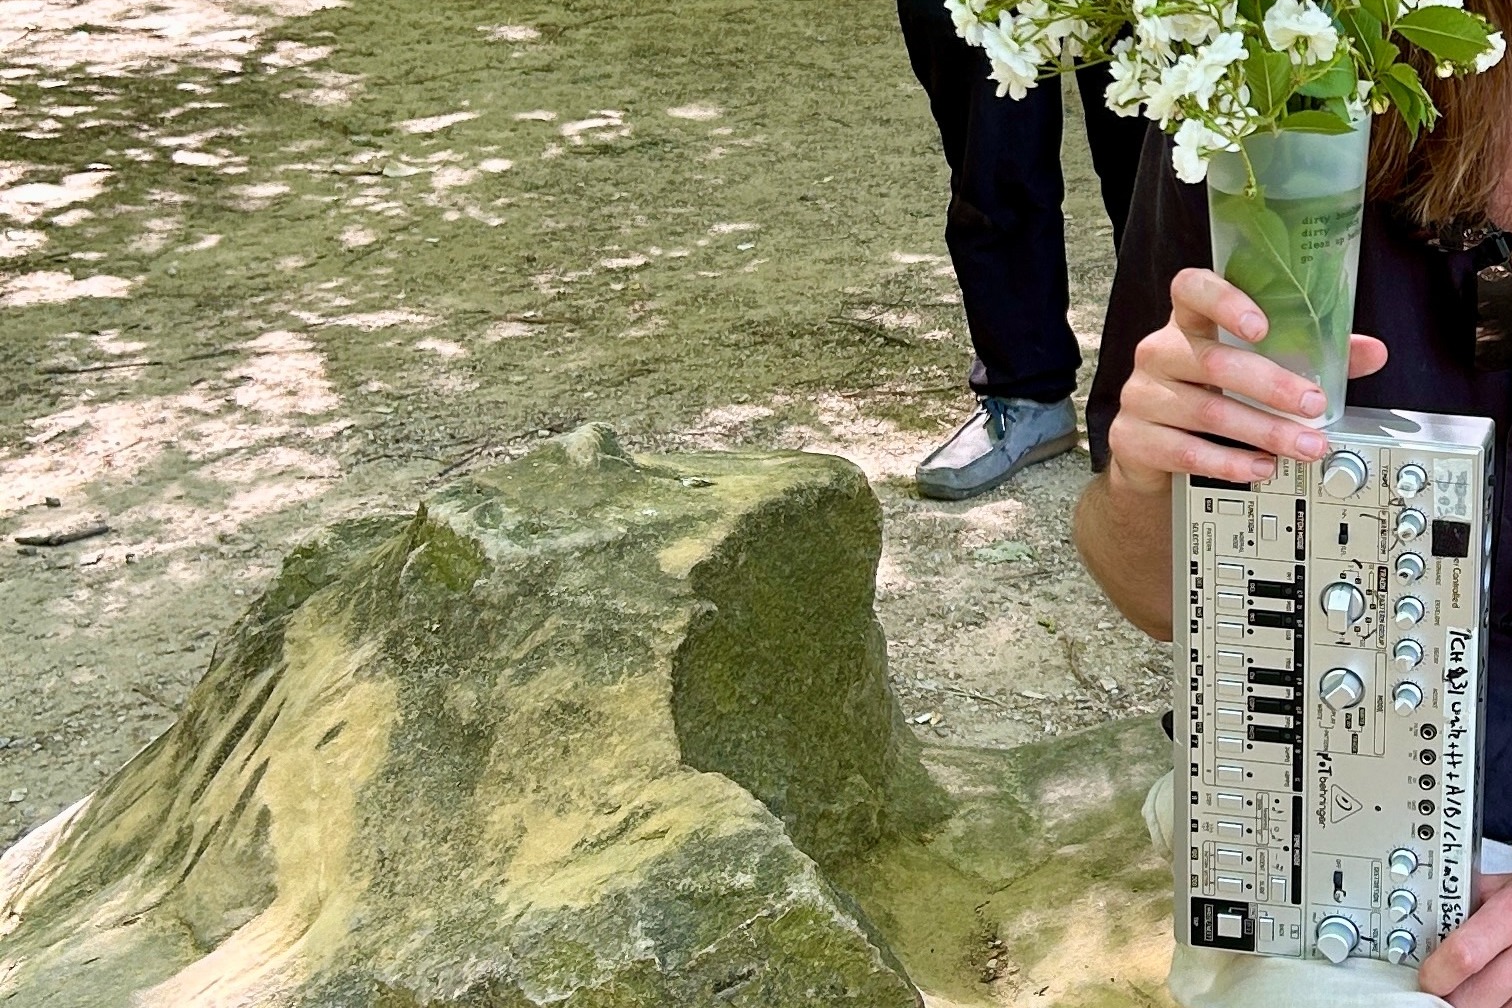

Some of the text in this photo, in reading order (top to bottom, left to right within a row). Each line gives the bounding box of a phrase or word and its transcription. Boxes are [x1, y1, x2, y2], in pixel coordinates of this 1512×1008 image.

[1302, 215, 1330, 225] dirty
[1301, 228, 1329, 237] dirty
[1300, 241, 1330, 249] clean
[1452, 568, 1461, 609] Controlled
[1316, 776, 1329, 829] behringer
